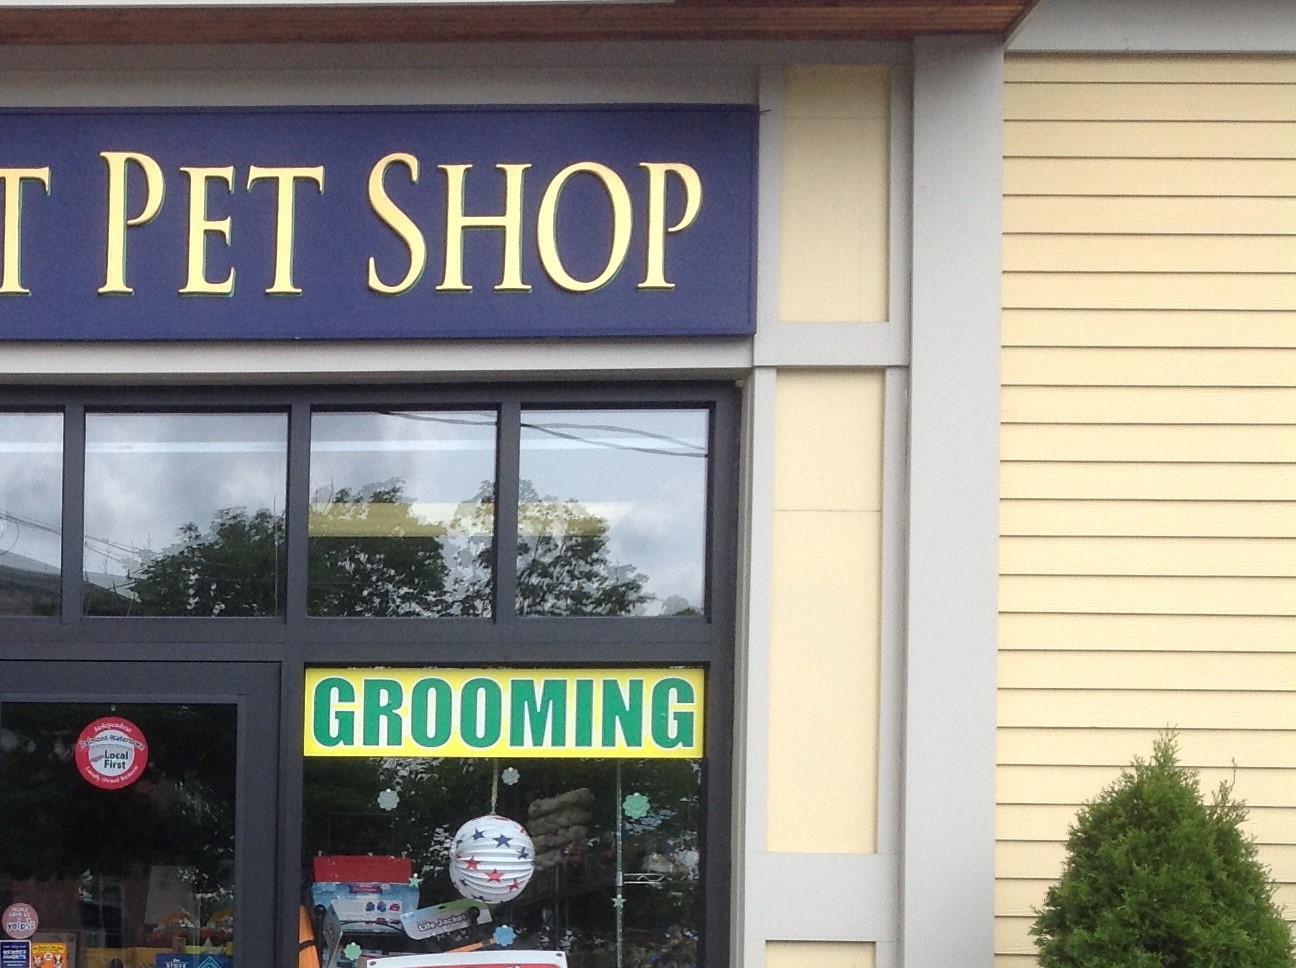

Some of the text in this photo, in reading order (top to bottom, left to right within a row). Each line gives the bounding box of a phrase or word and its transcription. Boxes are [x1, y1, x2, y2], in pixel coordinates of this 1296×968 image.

[97, 150, 326, 297] PET
[367, 151, 704, 296] SHOP
[312, 676, 696, 750] GROOMING
[104, 750, 129, 760] Local
[104, 760, 126, 769] First
[6, 921, 26, 931] yelp
[417, 921, 436, 932] Life
